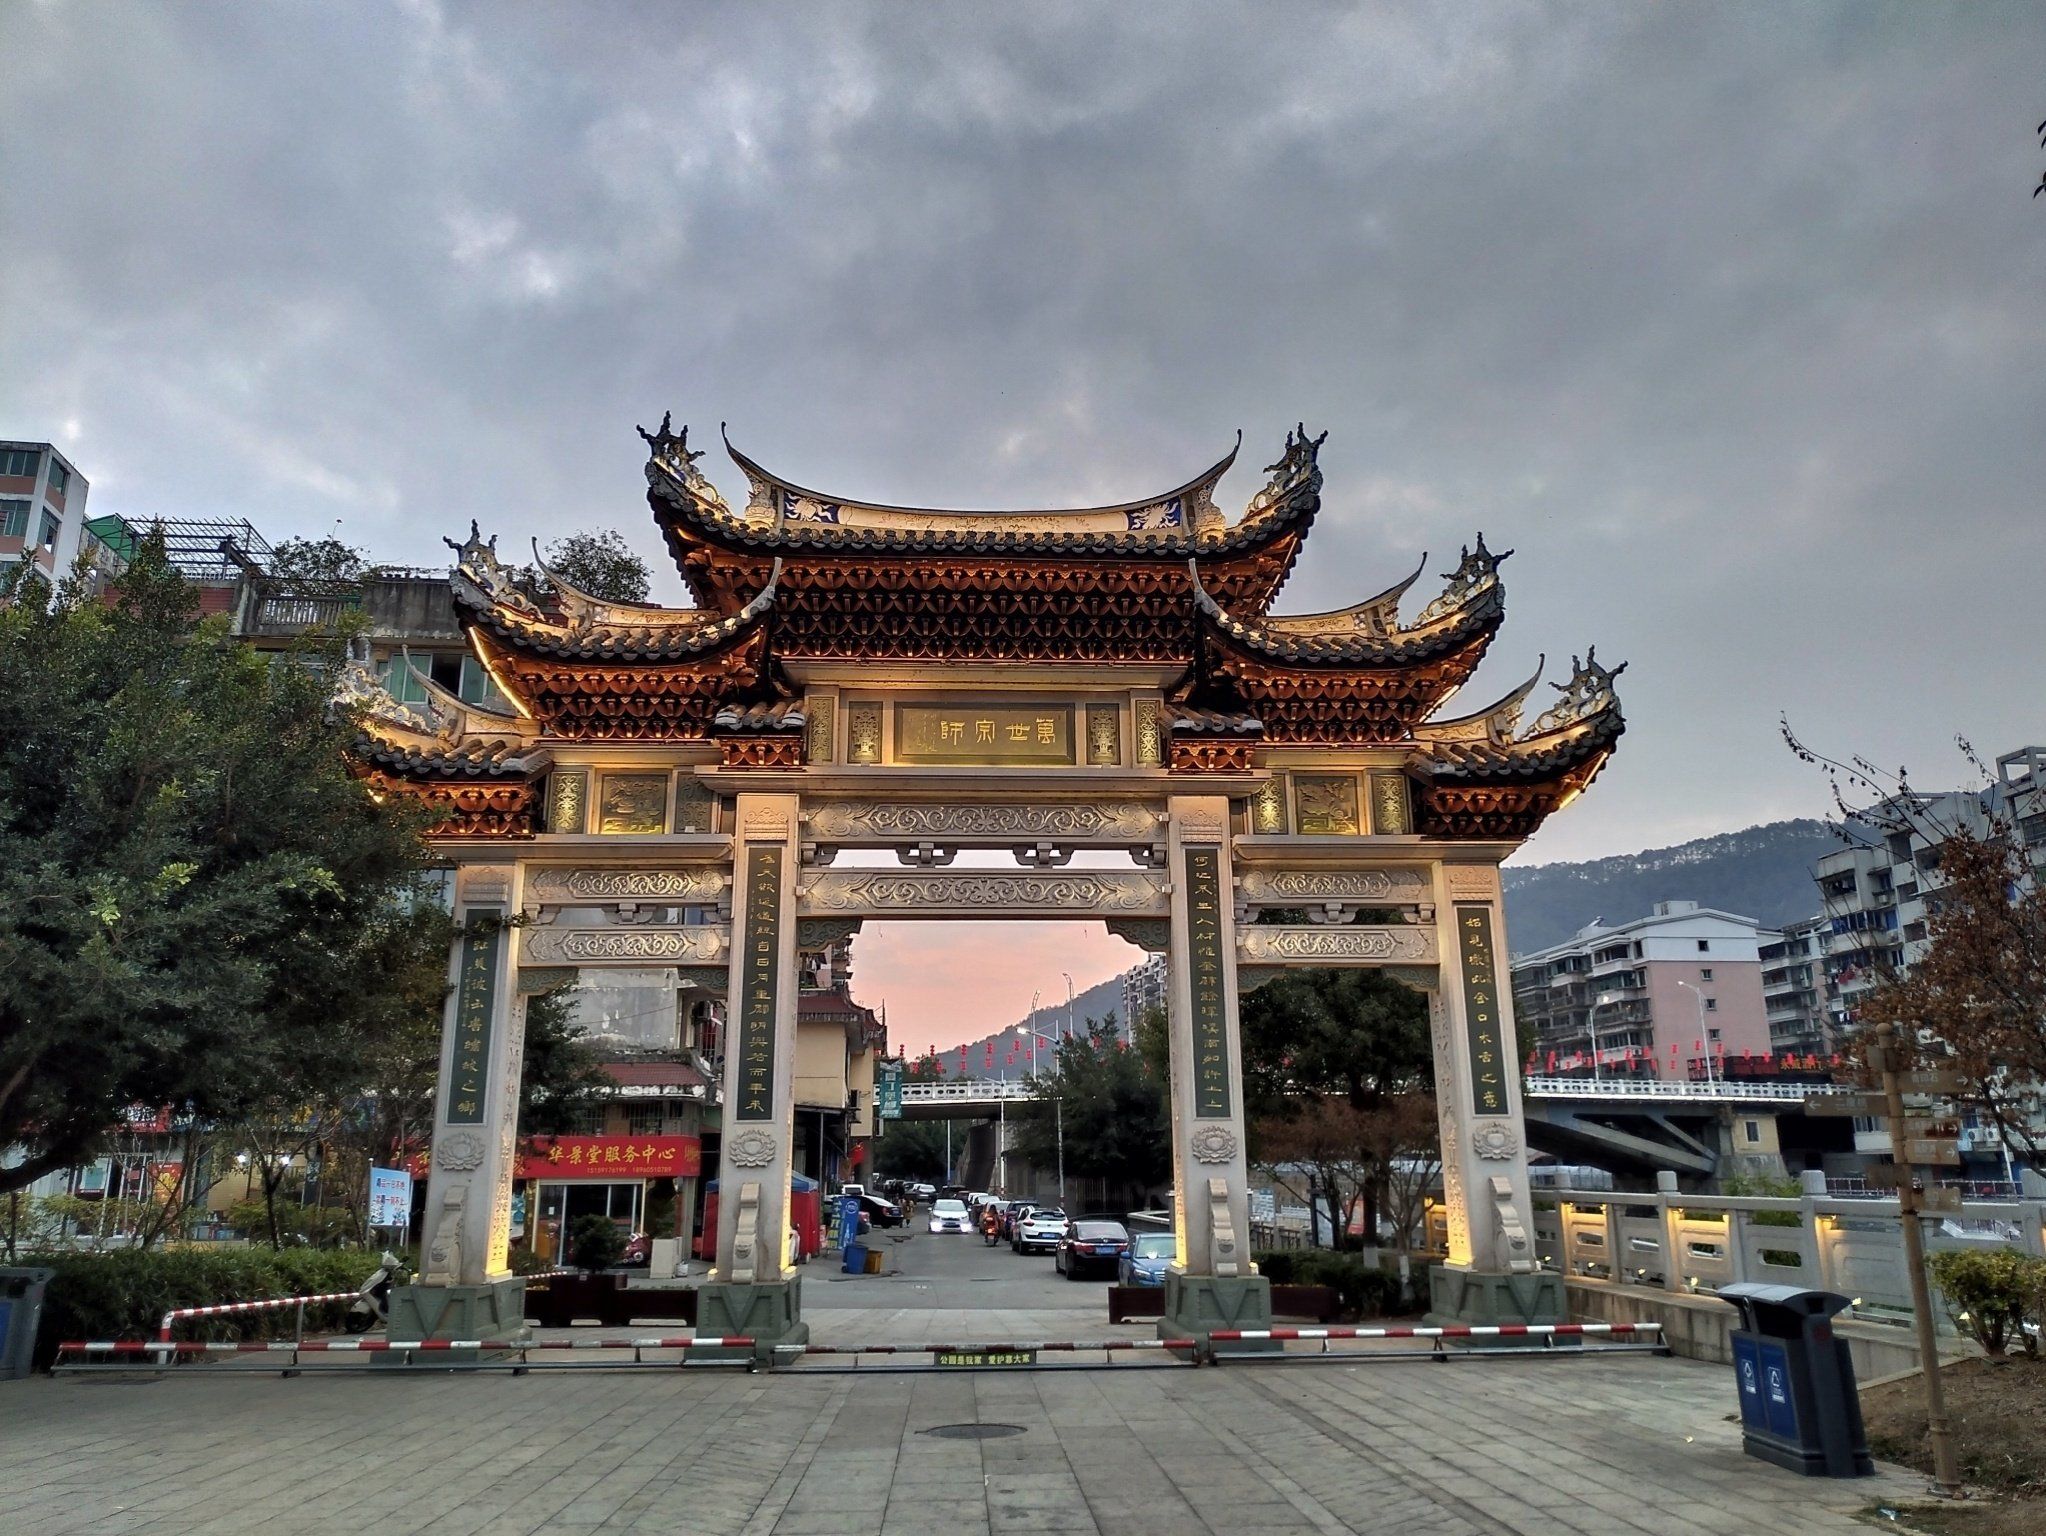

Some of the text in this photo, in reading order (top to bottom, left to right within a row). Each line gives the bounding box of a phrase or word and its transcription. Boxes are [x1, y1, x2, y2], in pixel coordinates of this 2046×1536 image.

[547, 1144, 676, 1165] 华景堂服务中心
